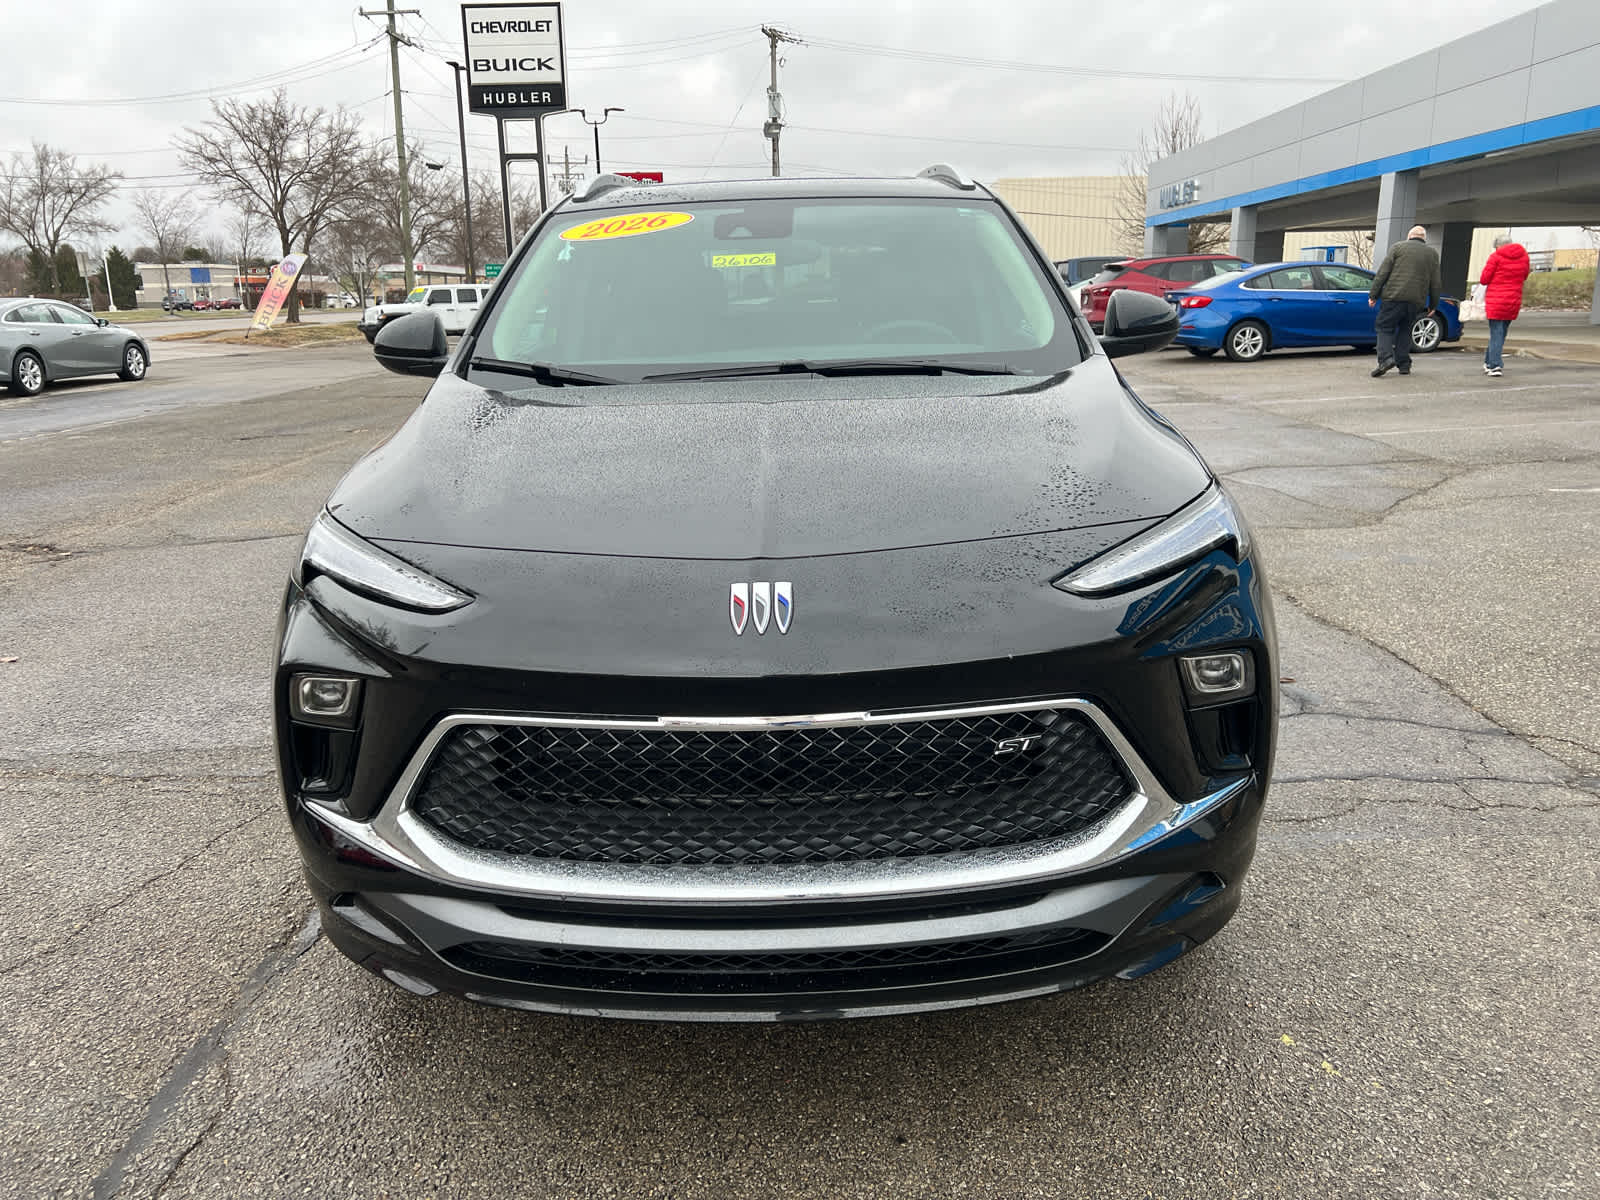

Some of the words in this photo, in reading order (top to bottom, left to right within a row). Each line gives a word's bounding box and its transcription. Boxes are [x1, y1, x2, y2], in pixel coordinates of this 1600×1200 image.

[471, 20, 553, 34] CHEVROLET
[473, 57, 555, 72] BUICK
[483, 91, 552, 105] HUBLER
[580, 213, 673, 238] 2026
[258, 277, 288, 327] BUICK
[994, 734, 1042, 756] ST
